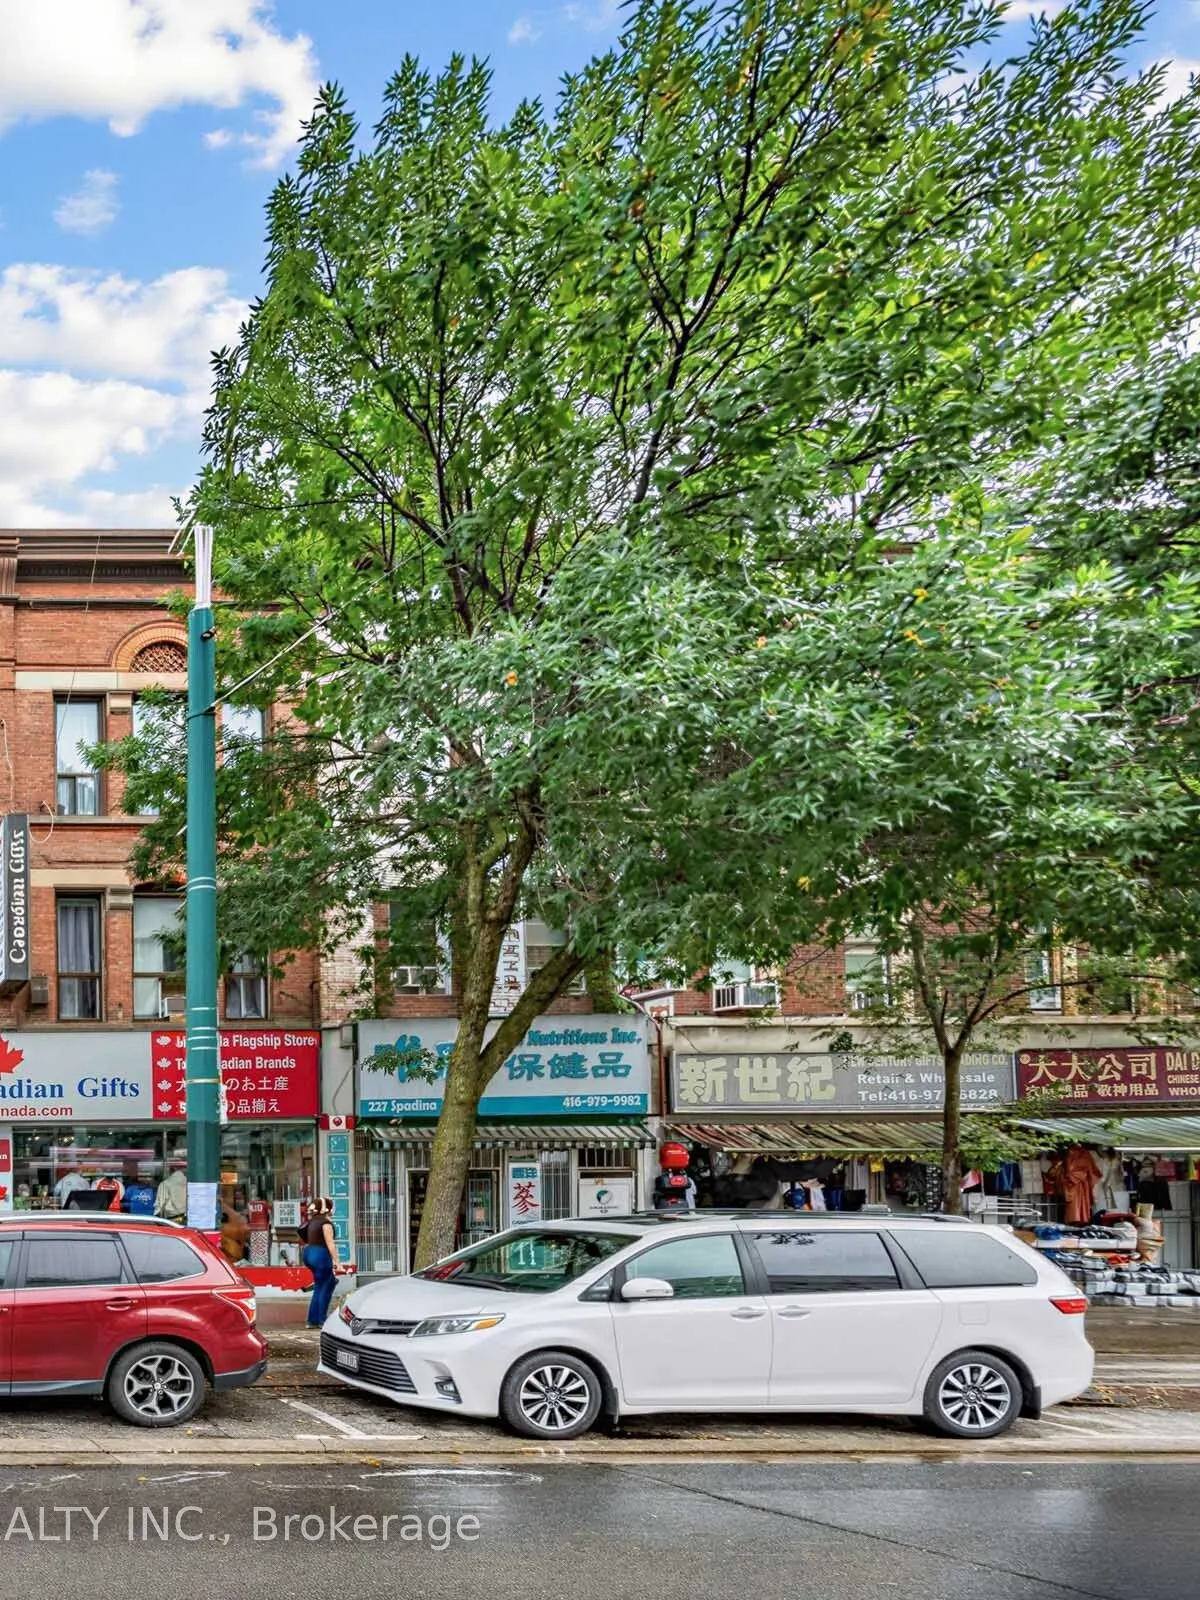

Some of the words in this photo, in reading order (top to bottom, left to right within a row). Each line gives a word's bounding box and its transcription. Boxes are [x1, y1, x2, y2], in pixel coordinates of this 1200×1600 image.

[233, 1035, 281, 1049] Flagship
[284, 1034, 315, 1046] Store
[611, 1027, 642, 1044] Inc.
[255, 1057, 296, 1069] Brands
[505, 1051, 632, 1080] 保健品
[1166, 1051, 1188, 1071] DAI
[679, 1055, 837, 1103] 新世紀
[904, 1073, 915, 1083] &
[77, 1077, 140, 1098] Gifts
[368, 1101, 388, 1112] 227
[391, 1100, 437, 1113] Spadina
[563, 1095, 641, 1108] 416-979-9982
